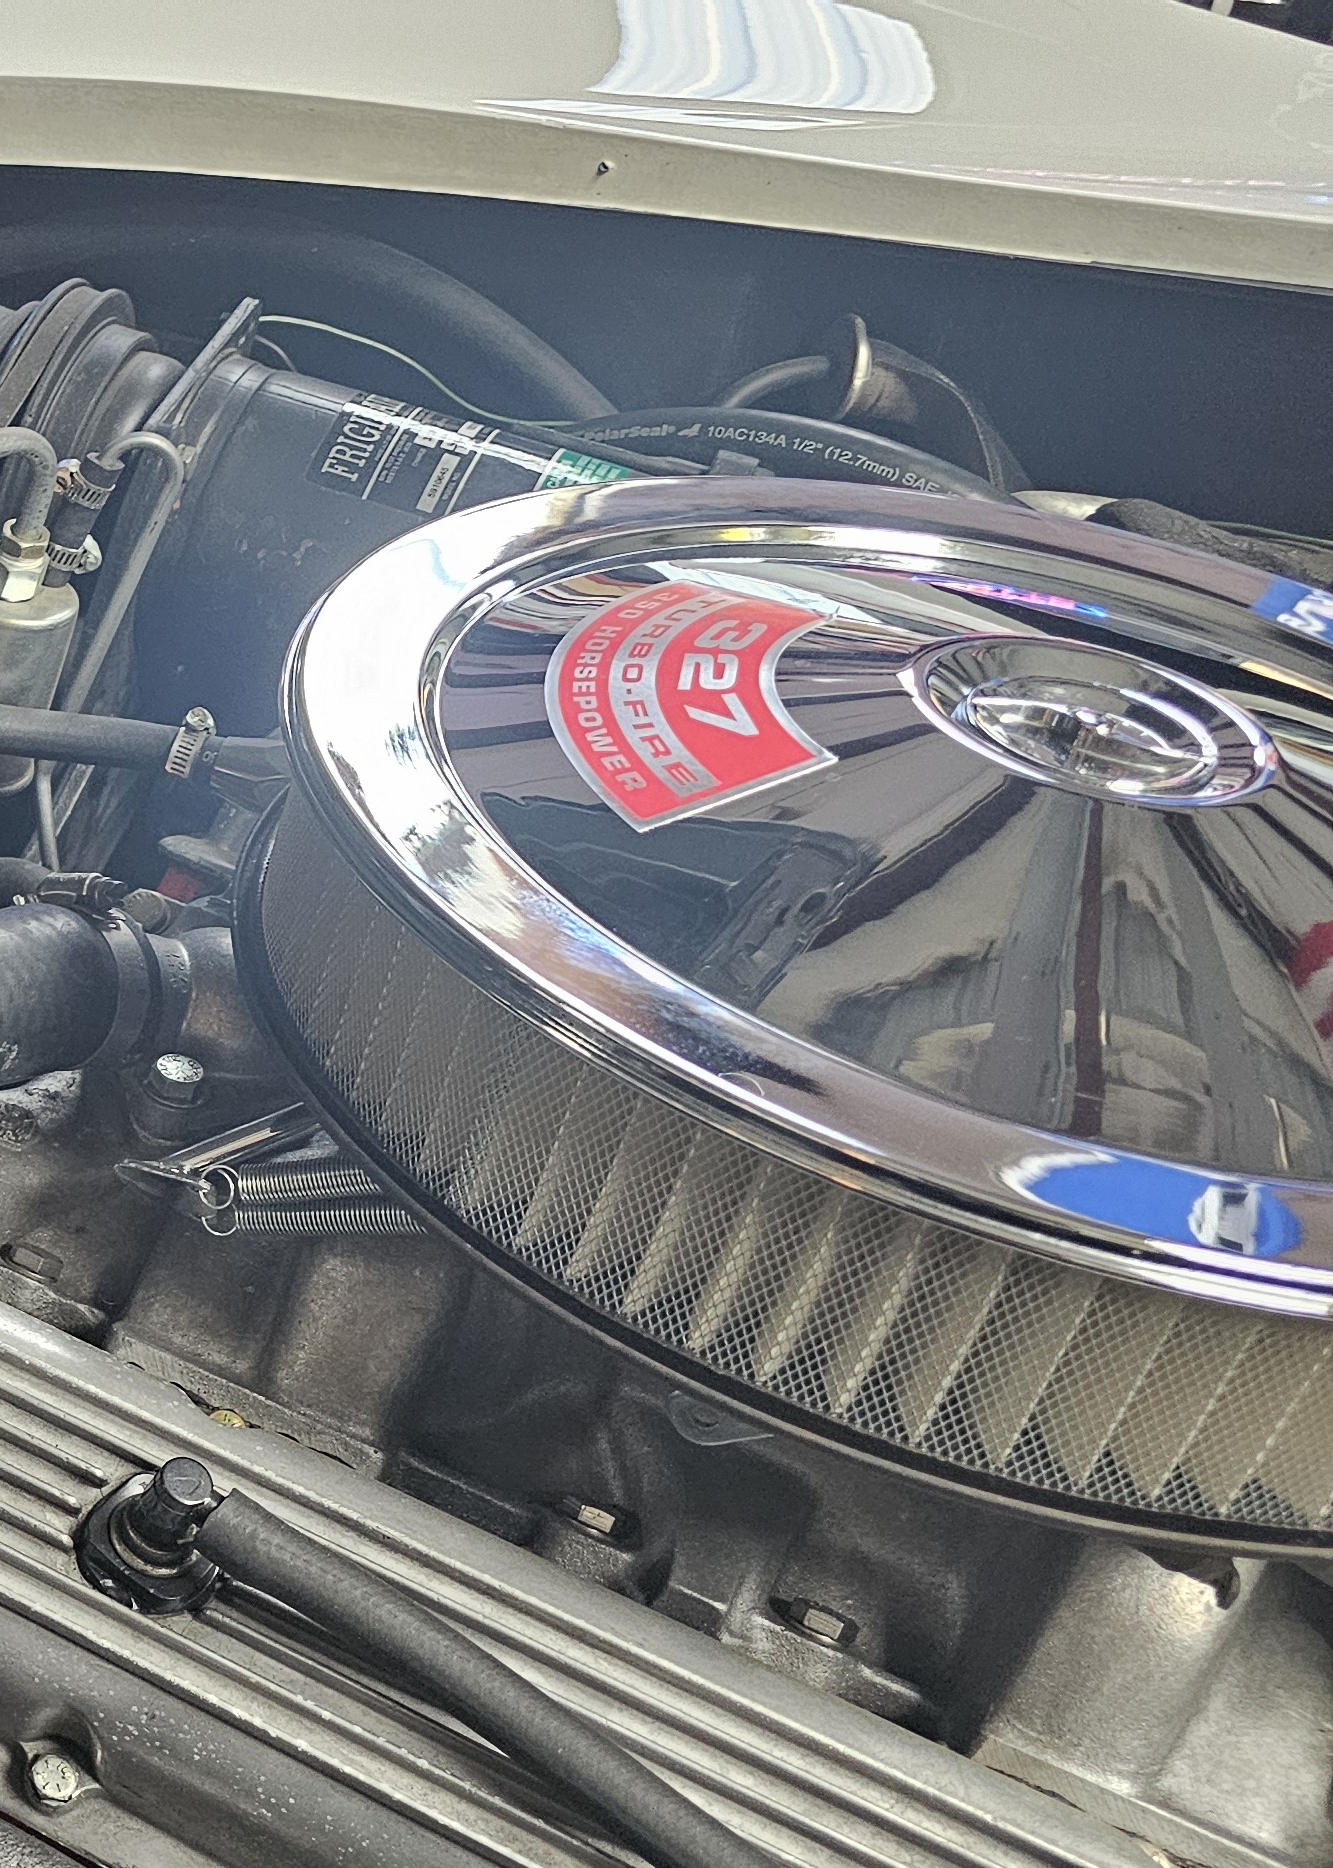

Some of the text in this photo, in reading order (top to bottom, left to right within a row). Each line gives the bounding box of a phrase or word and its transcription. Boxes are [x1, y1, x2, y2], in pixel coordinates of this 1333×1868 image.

[707, 425, 787, 447] 10AC134A
[792, 437, 824, 454] 1/2"
[824, 445, 901, 482] (12.7mm)
[572, 591, 680, 792] 350 HORSEPOWER
[677, 619, 769, 737] 327
